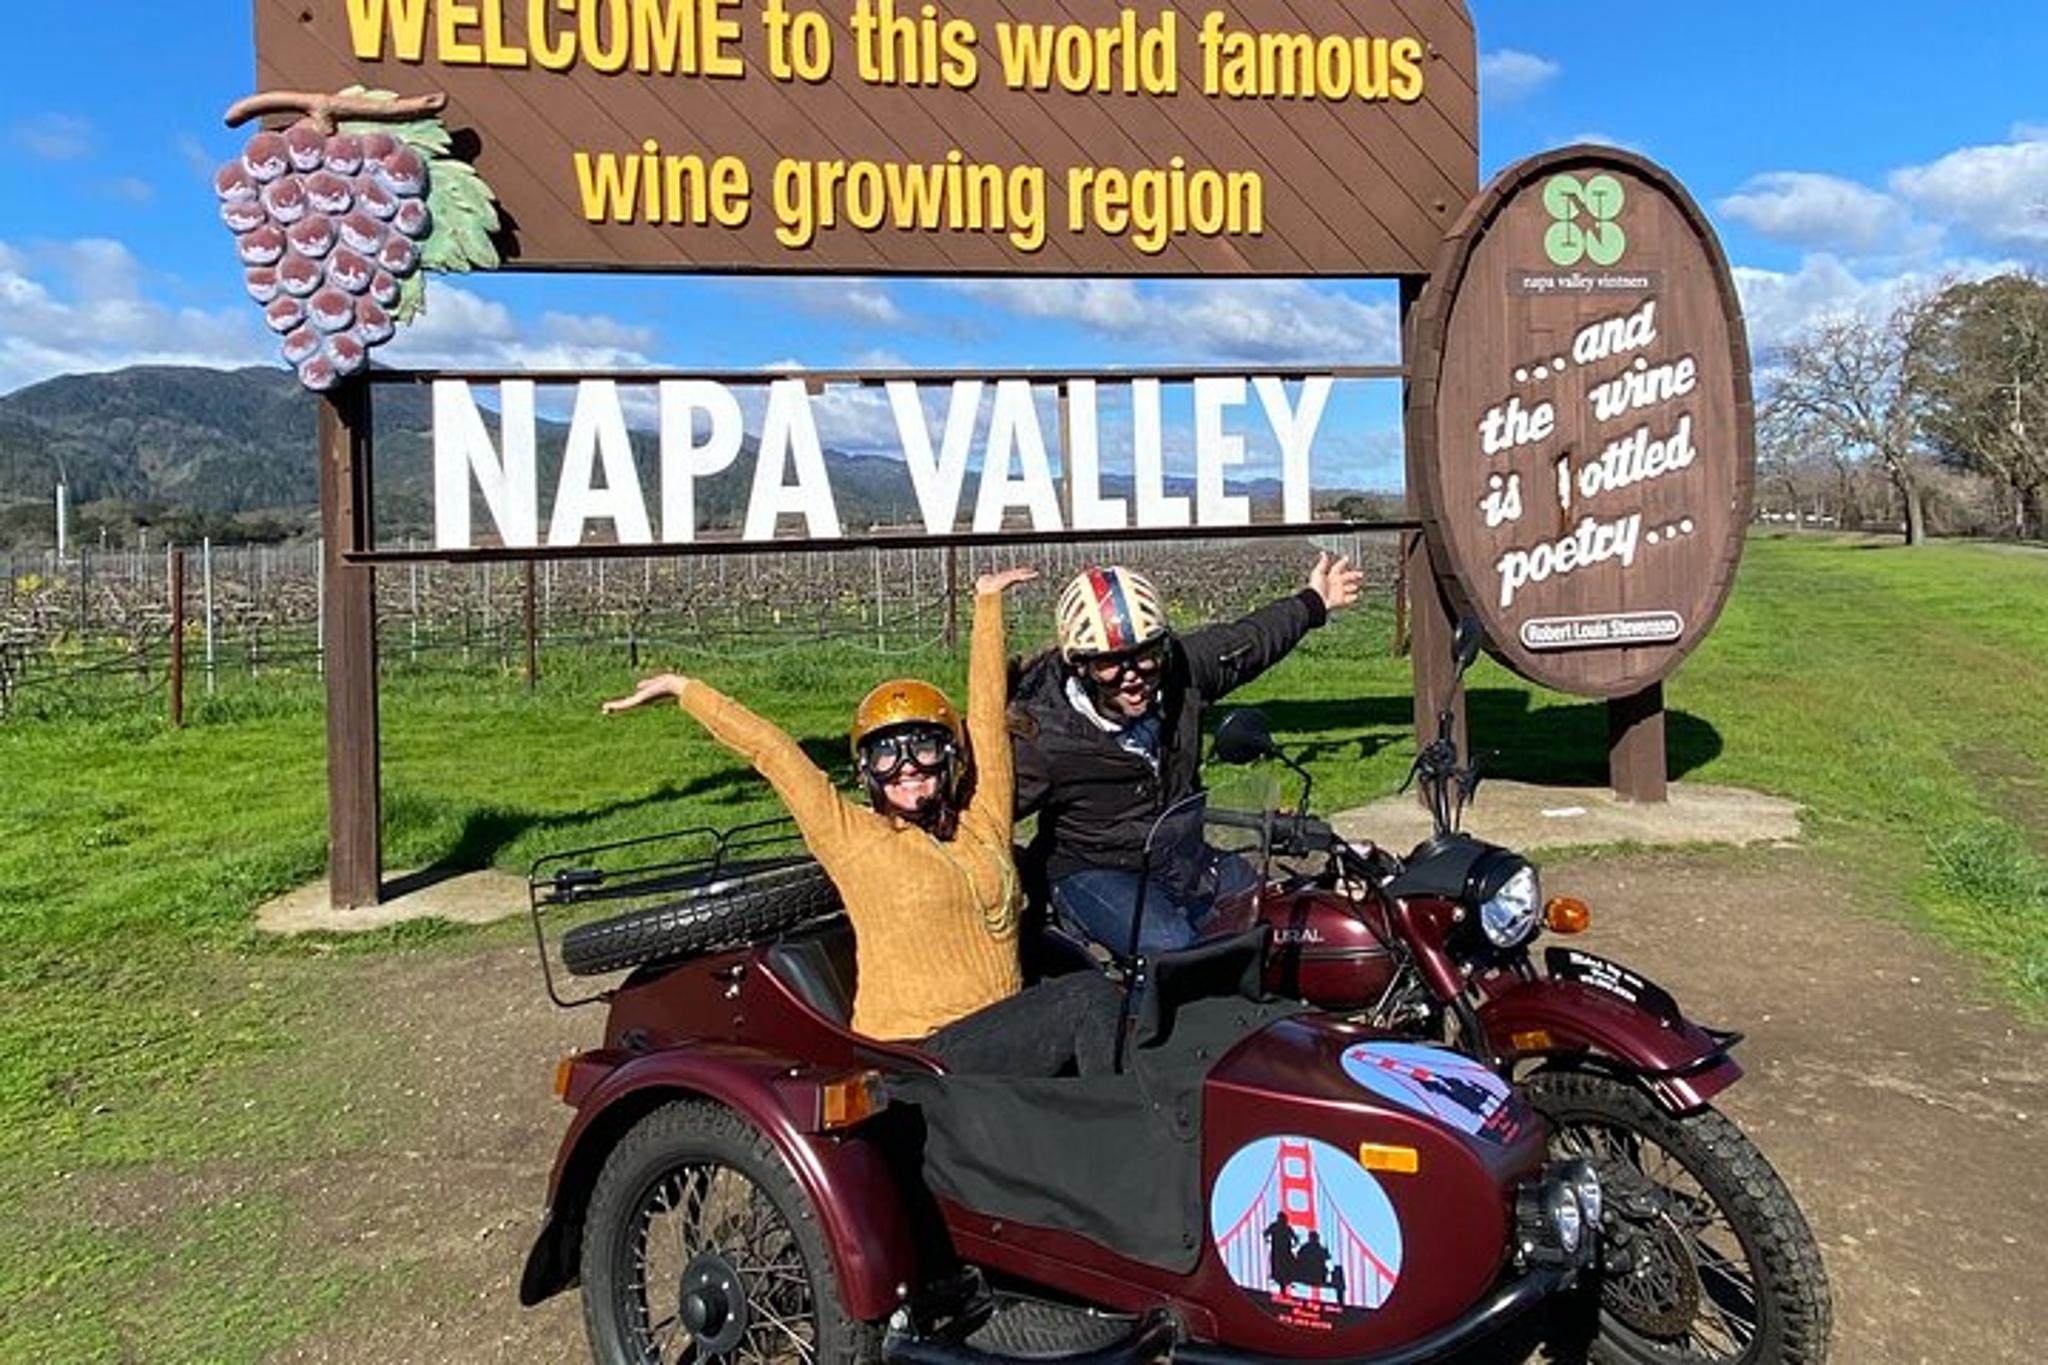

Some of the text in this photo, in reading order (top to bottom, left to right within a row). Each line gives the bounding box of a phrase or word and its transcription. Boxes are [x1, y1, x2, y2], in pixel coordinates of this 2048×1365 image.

[345, 0, 1425, 101] WELCOME to this world famous
[574, 139, 1263, 252] wine growing region
[1523, 272, 1649, 293] napa valley vintners
[1480, 357, 1697, 455] the wine
[432, 377, 1335, 550] NAPA VALLEY
[1480, 474, 1522, 528] is
[1528, 617, 1677, 642] Robert Louis Stevenson
[1273, 928, 1325, 944] URAL
